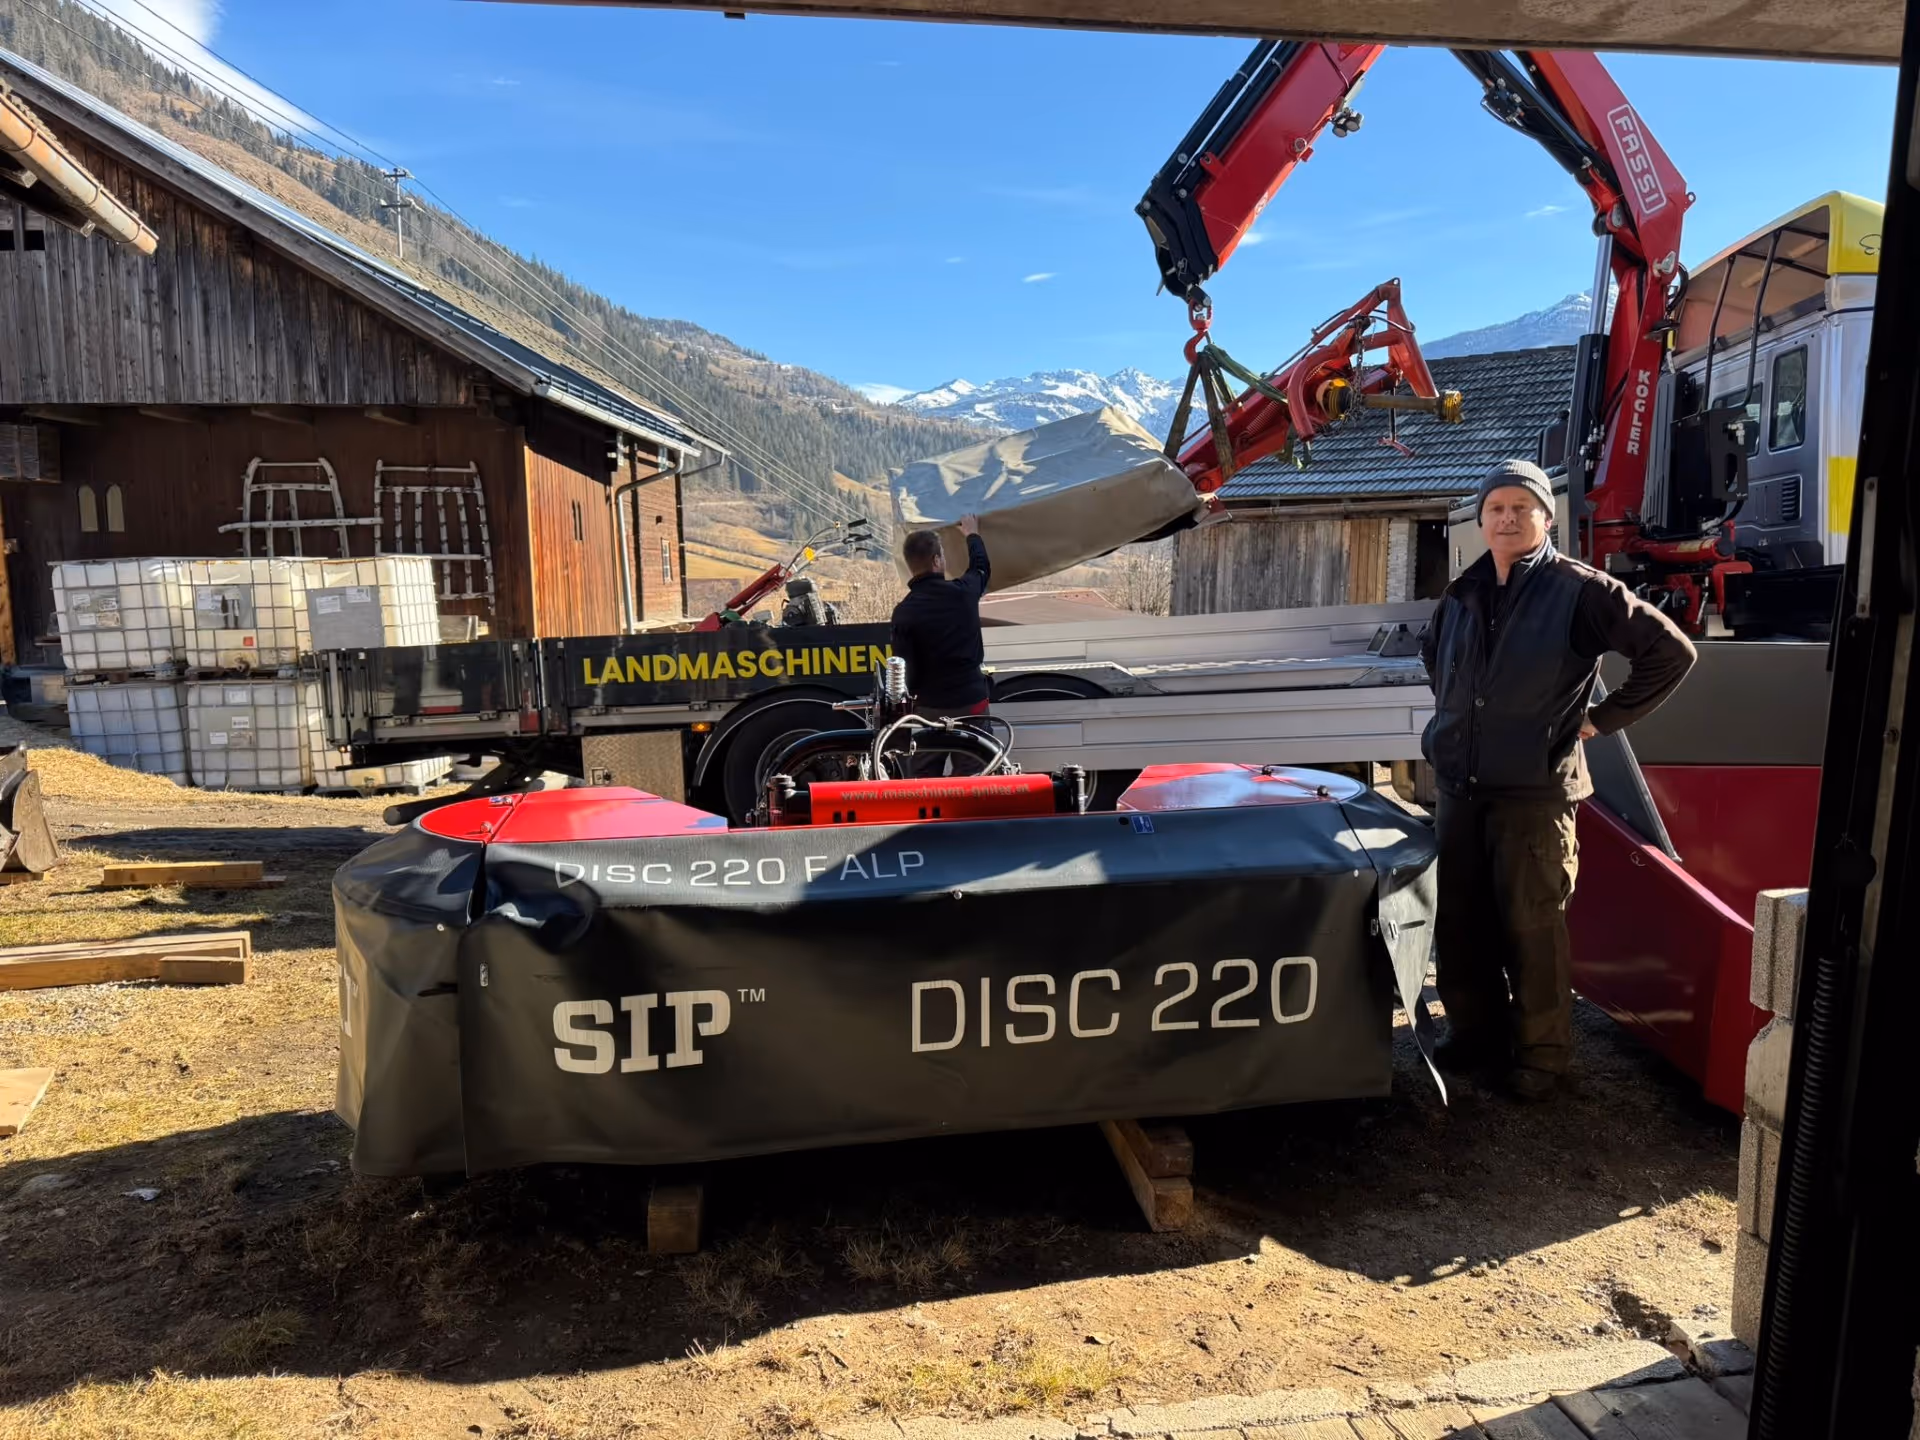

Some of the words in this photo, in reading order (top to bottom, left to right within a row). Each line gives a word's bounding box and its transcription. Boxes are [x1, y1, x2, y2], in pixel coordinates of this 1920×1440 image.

[1615, 116, 1660, 203] FASSI
[1626, 369, 1651, 455] KOGLER
[583, 644, 892, 684] LANDMASCHINEN
[555, 862, 672, 888] DISC
[690, 858, 785, 886] 220
[805, 855, 827, 883] F
[840, 851, 924, 881] ALP
[553, 989, 731, 1074] SIP
[912, 968, 1120, 1052] DISC
[1151, 956, 1318, 1031] 220
